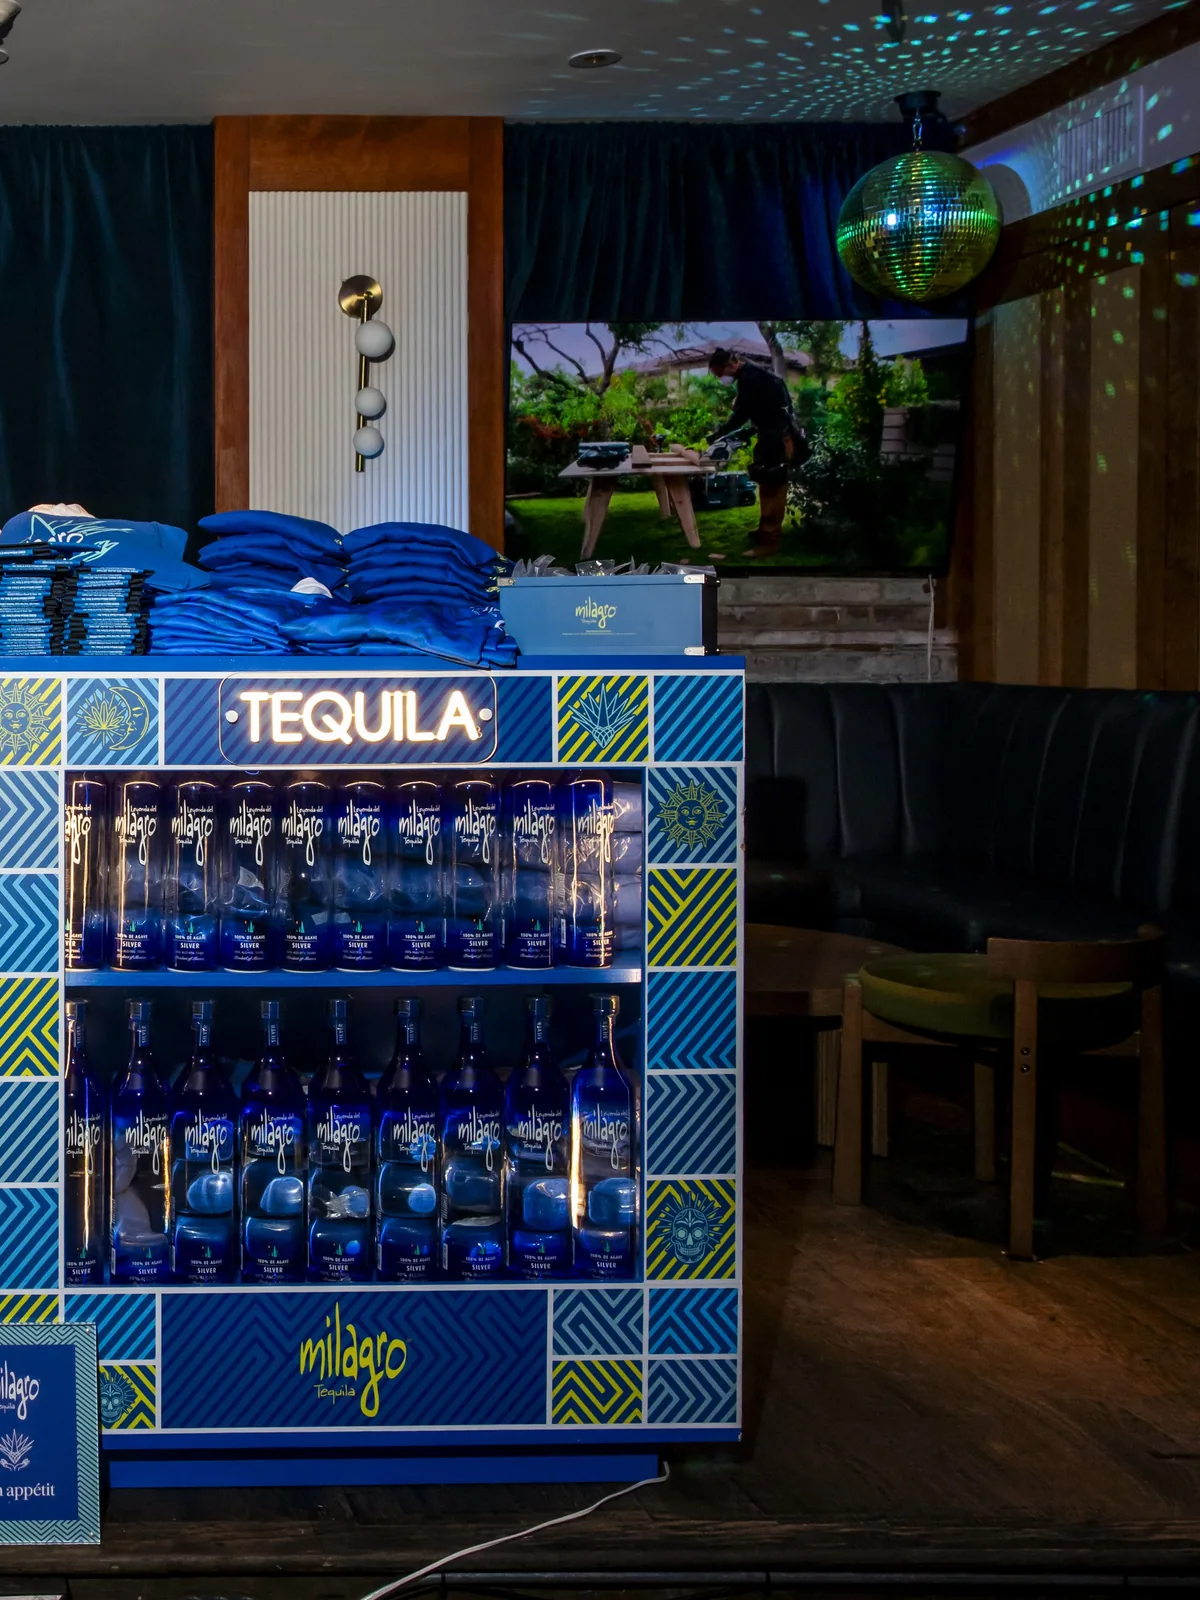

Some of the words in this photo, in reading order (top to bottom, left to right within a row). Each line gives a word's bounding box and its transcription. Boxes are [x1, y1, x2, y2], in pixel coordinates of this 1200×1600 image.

[575, 597, 616, 628] milagro
[240, 690, 480, 744] TEQUILA
[115, 799, 156, 865] milagro
[172, 800, 213, 866] milagro
[230, 799, 271, 866] milagro
[282, 800, 323, 866] milagro
[338, 799, 379, 866] milagro
[399, 799, 440, 865] milagro
[455, 798, 495, 864] milagro
[514, 798, 554, 864] milagro
[126, 1110, 168, 1175] milagro
[185, 1109, 227, 1174] milagro
[251, 1108, 294, 1175] milagro
[317, 1106, 360, 1173] milagro
[393, 1106, 435, 1172] milagro
[458, 1106, 500, 1171] milagro
[518, 1104, 562, 1171] milagro
[584, 1103, 627, 1170] milagro
[300, 1302, 407, 1418] milagro
[314, 1384, 356, 1405] Tequila
[6, 1483, 55, 1500] appétit
